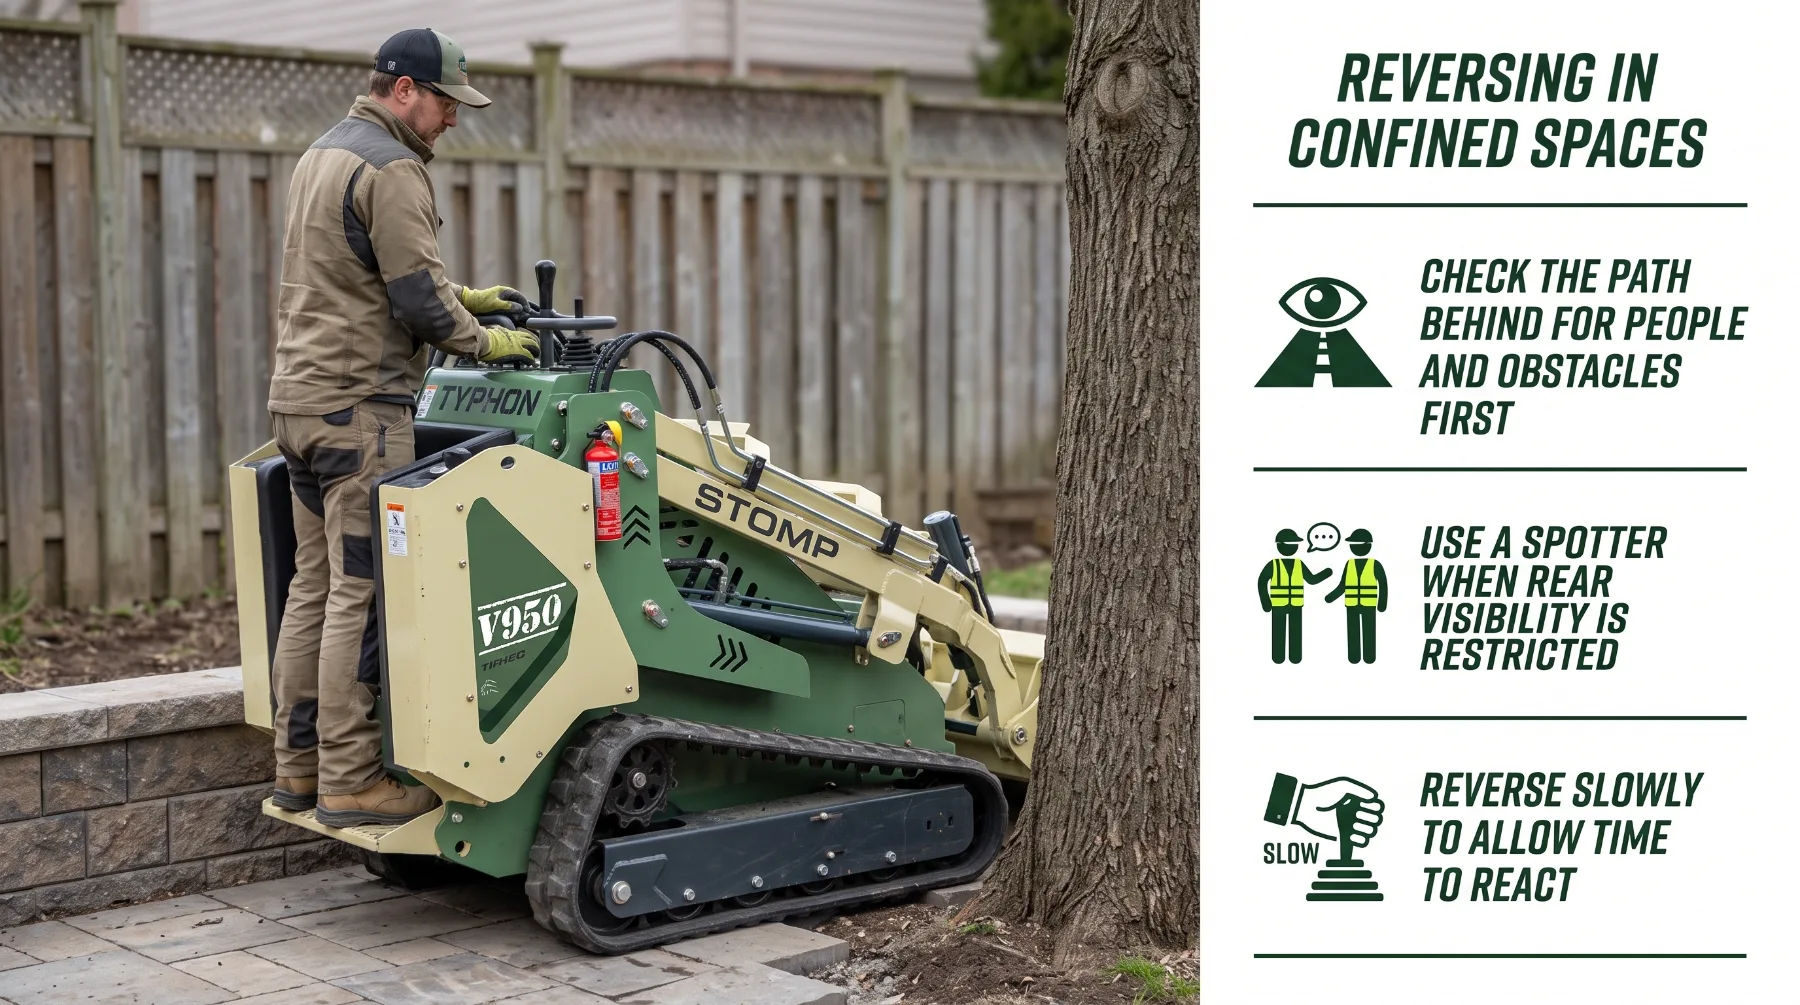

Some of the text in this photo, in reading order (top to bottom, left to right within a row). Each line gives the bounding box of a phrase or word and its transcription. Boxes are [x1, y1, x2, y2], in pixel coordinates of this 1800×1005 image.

[439, 385, 542, 416] TYPHON
[695, 483, 839, 558] STOMP
[478, 593, 562, 647] V950
